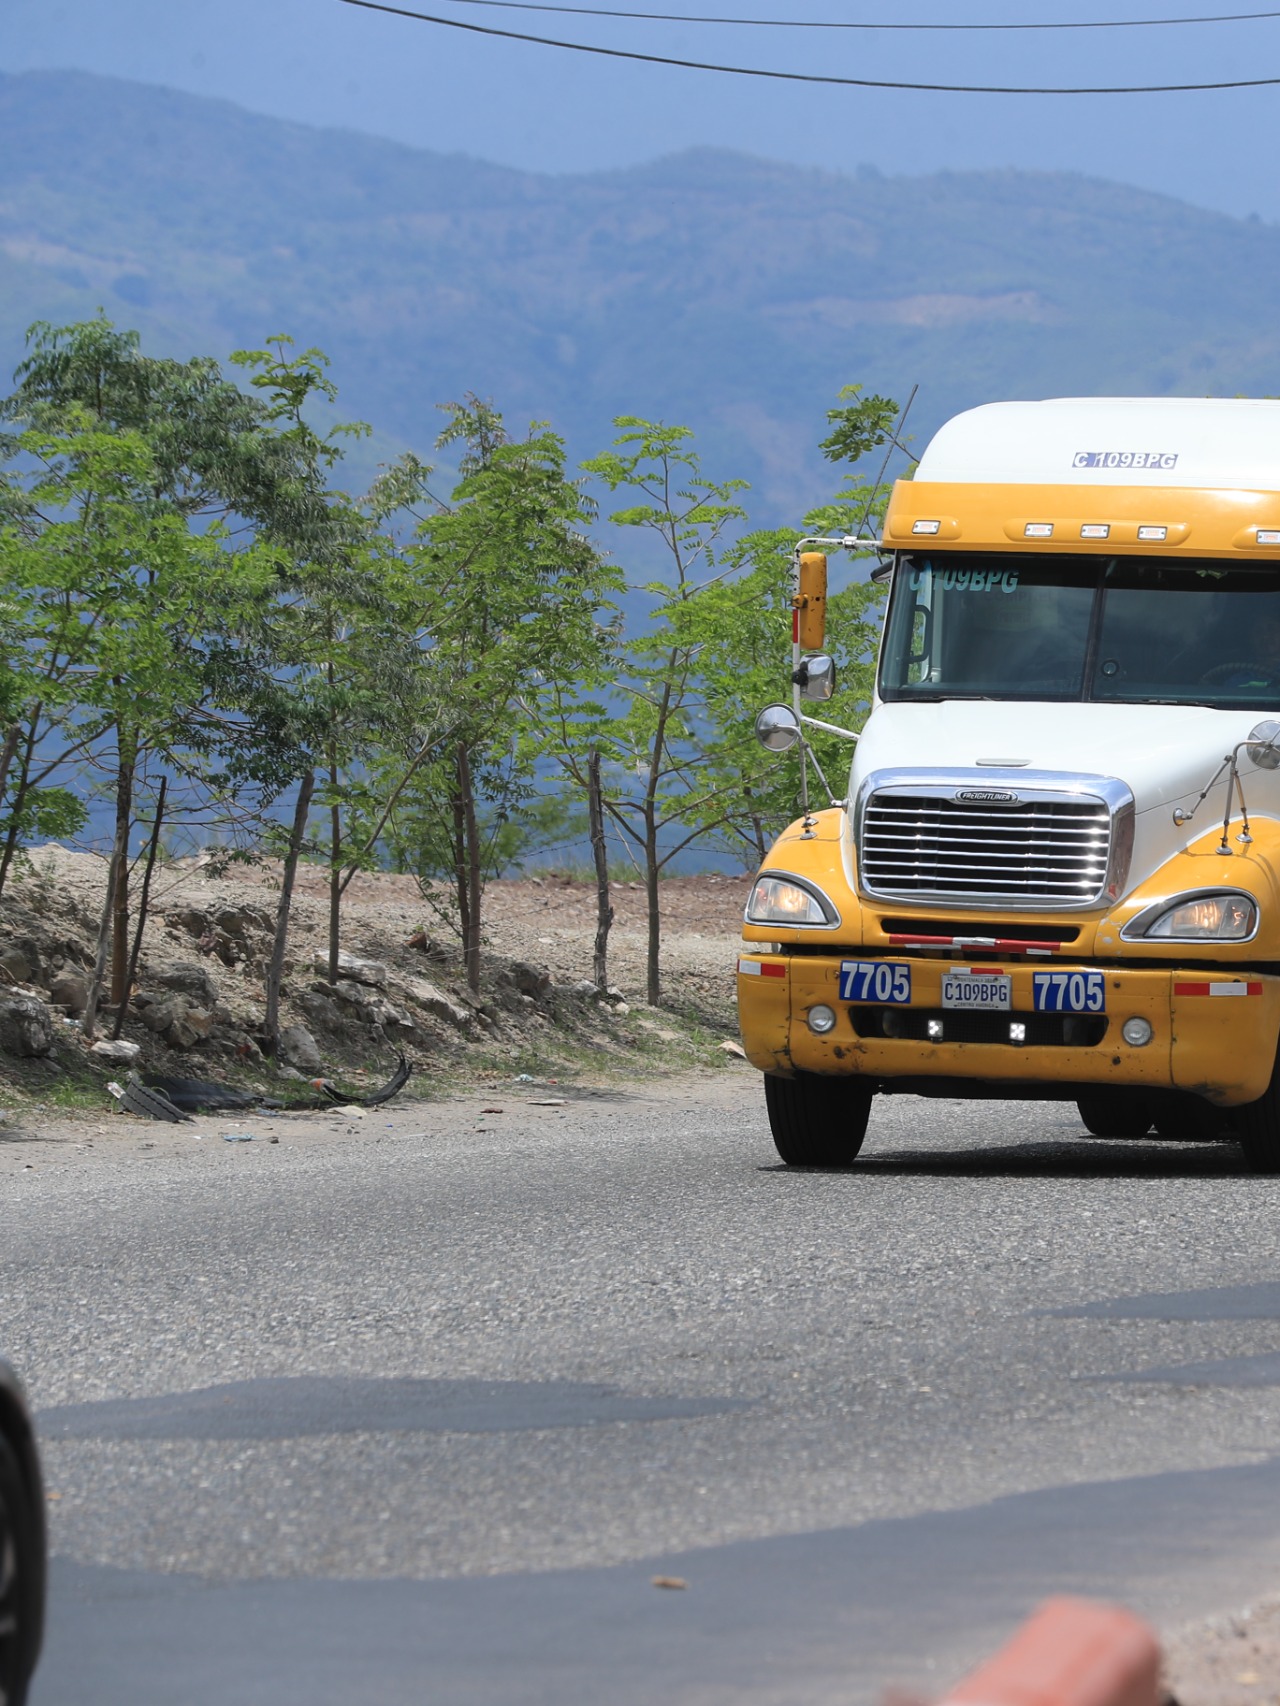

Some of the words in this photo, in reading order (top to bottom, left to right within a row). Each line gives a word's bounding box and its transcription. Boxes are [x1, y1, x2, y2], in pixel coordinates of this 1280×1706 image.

[1074, 453, 1089, 468] C
[1095, 453, 1176, 469] 109BPG
[932, 568, 1020, 594] 109BPG
[962, 792, 1010, 801] FREIGHTLINER
[842, 962, 910, 1002] 7705
[945, 983, 1007, 1002] C109BPG
[1034, 974, 1104, 1011] 7705
